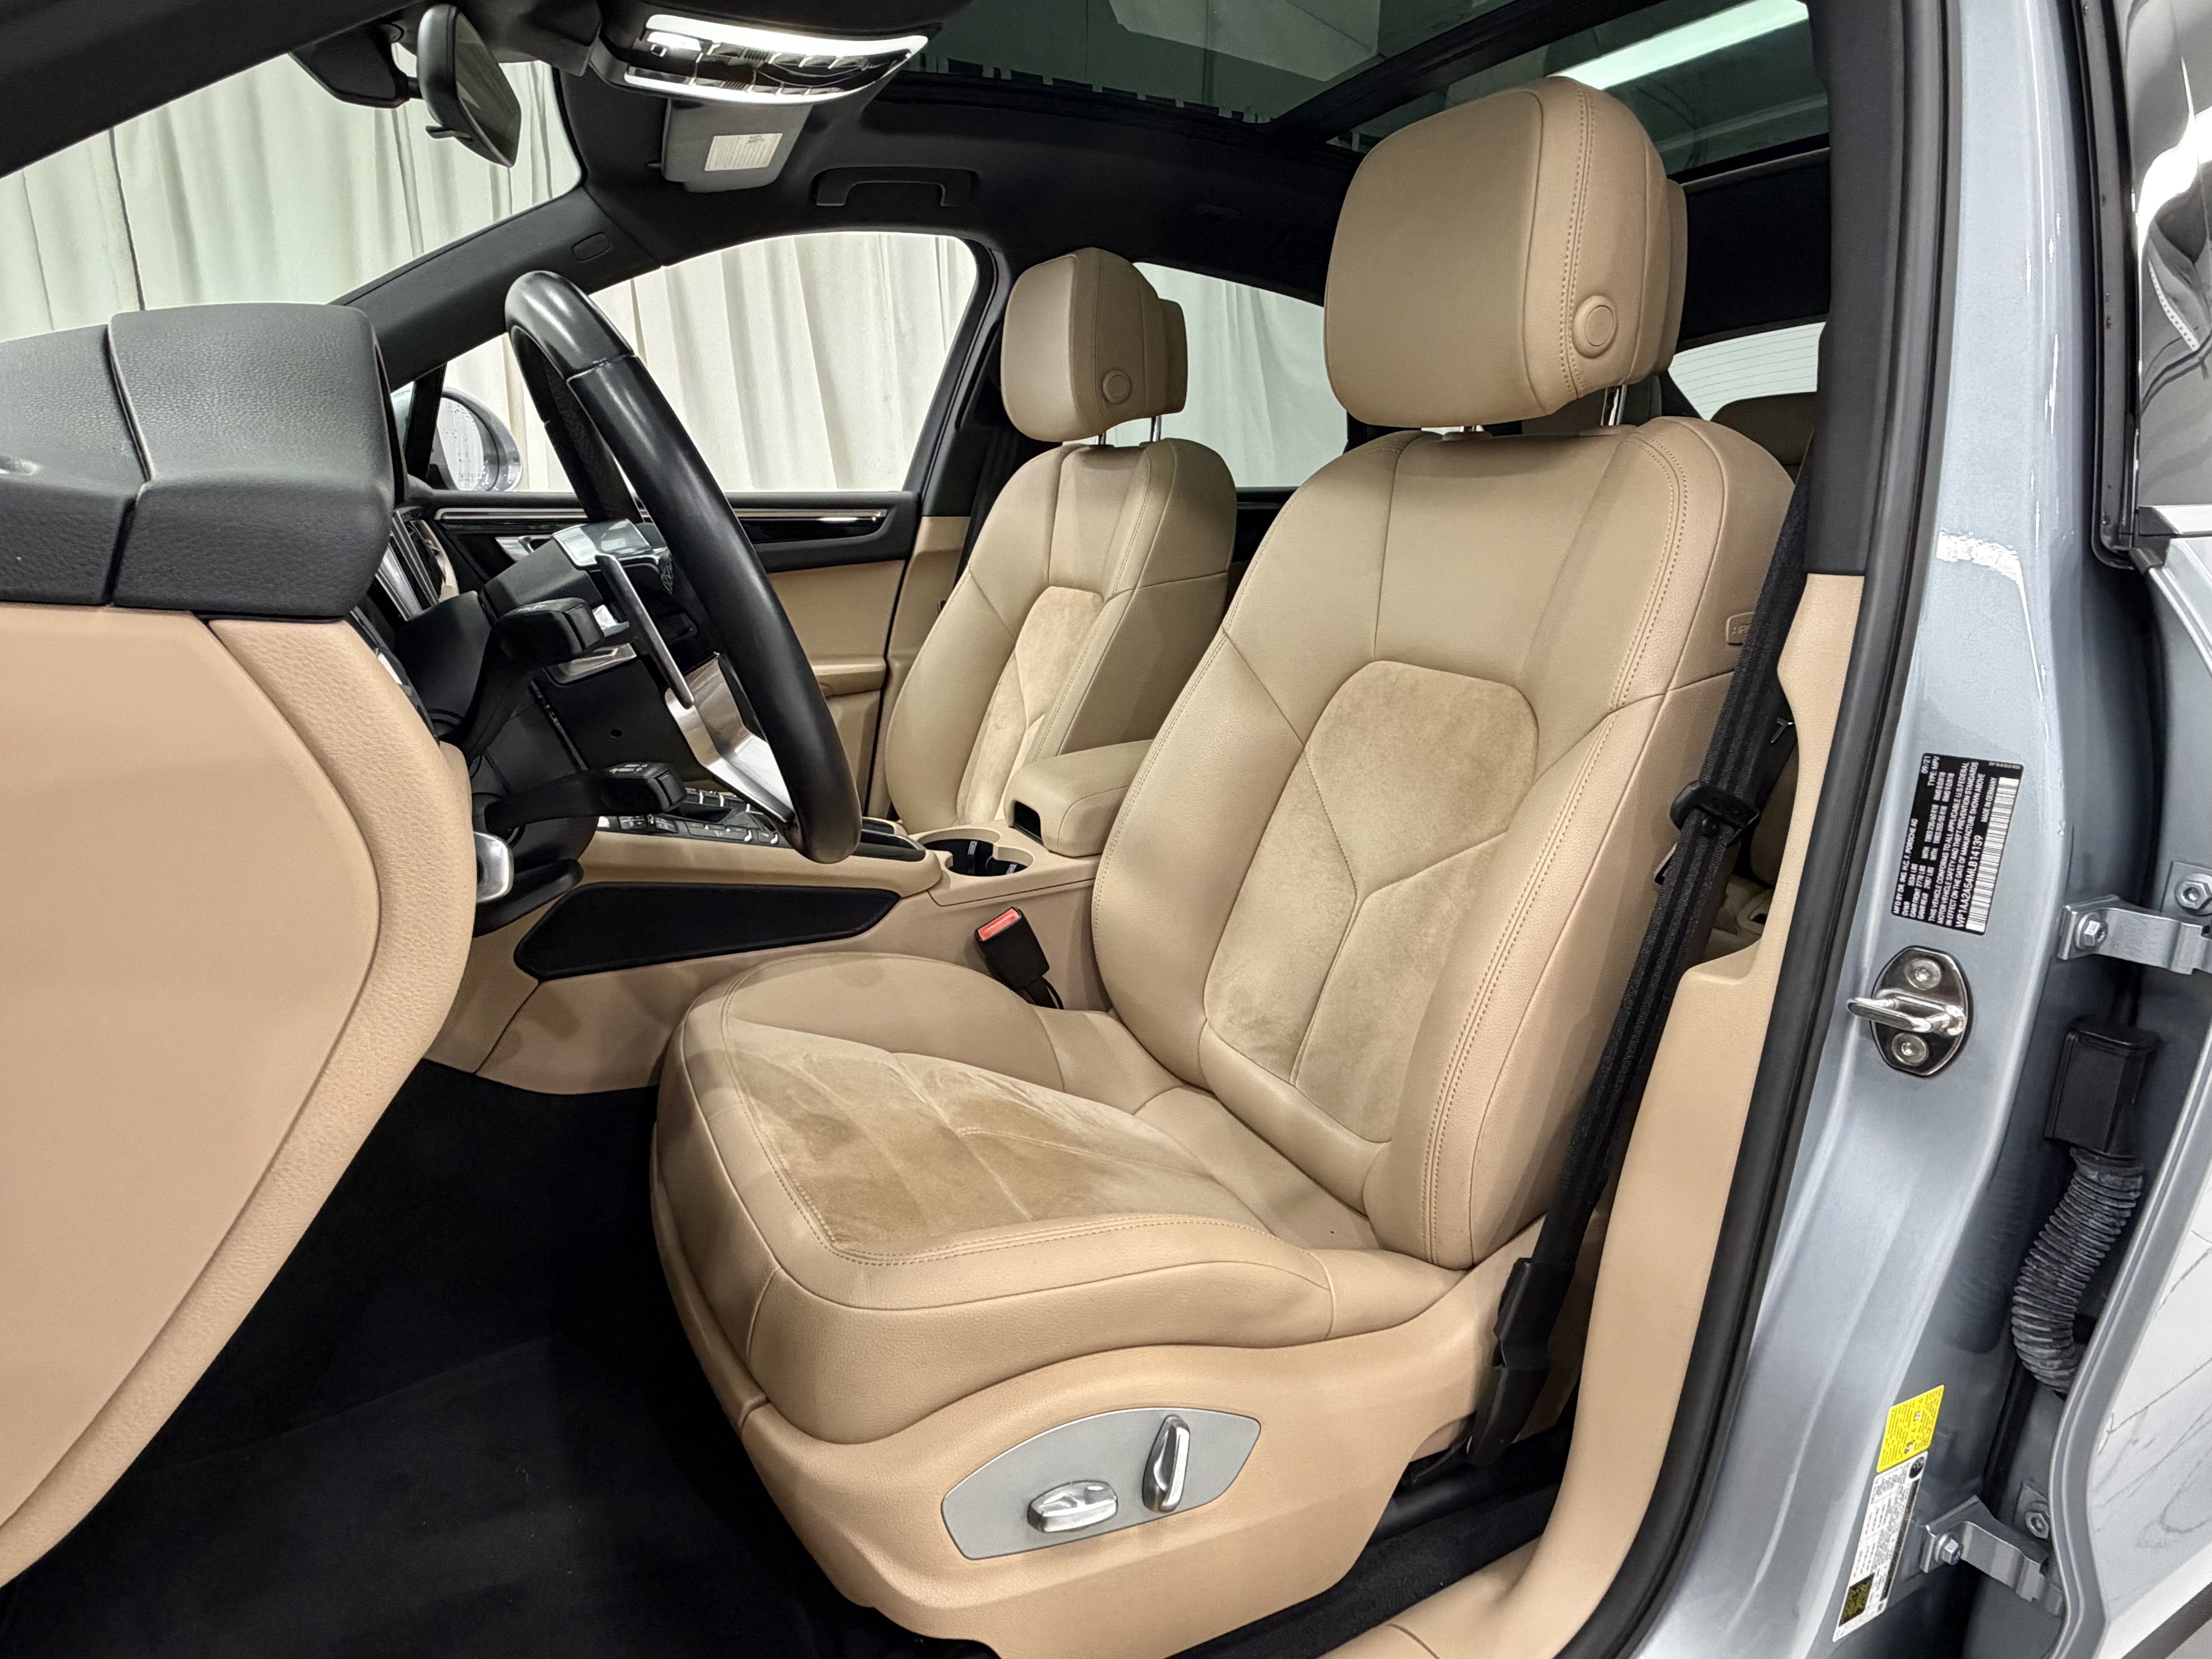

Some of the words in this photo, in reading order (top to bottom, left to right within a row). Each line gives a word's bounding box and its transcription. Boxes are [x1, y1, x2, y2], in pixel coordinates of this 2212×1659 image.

[1931, 756, 1940, 769] MPV
[1965, 762, 1979, 795] STANDARDS
[1974, 773, 1985, 792] ABOVE
[1969, 792, 1980, 815] SHOWN
[1980, 808, 1990, 823] MADE
[1985, 777, 1997, 802] GERMANY
[1948, 798, 1961, 833] APPLICABLE
[1957, 795, 1971, 830] PREVENTION
[1945, 833, 1953, 843] ALL
[1953, 830, 1963, 847] THEFT
[1960, 815, 1976, 856] MANUFACTURE
[1895, 893, 1903, 901] BY
[1905, 827, 1917, 854] PORSCHE
[1911, 819, 1918, 827] AG
[1950, 848, 1959, 860] AND
[1958, 856, 1966, 864] OF
[1936, 852, 1949, 884] CONFORMS
[1946, 860, 1956, 881] SAFETY
[1955, 864, 1965, 878] DATE
[1953, 878, 1961, 889] THE
[1955, 835, 1983, 927] WP1AA2A54MLB14139
[1912, 888, 1921, 904] FRONT
[1920, 893, 1929, 905] REAR
[1931, 884, 1942, 908] VEHICLE
[1941, 881, 1952, 903] VEHICLE
[1951, 890, 1959, 899] ON
[1928, 908, 1937, 921] THIS
[1937, 904, 1946, 924] MOTOR
[1946, 898, 1956, 919] EFFECT
